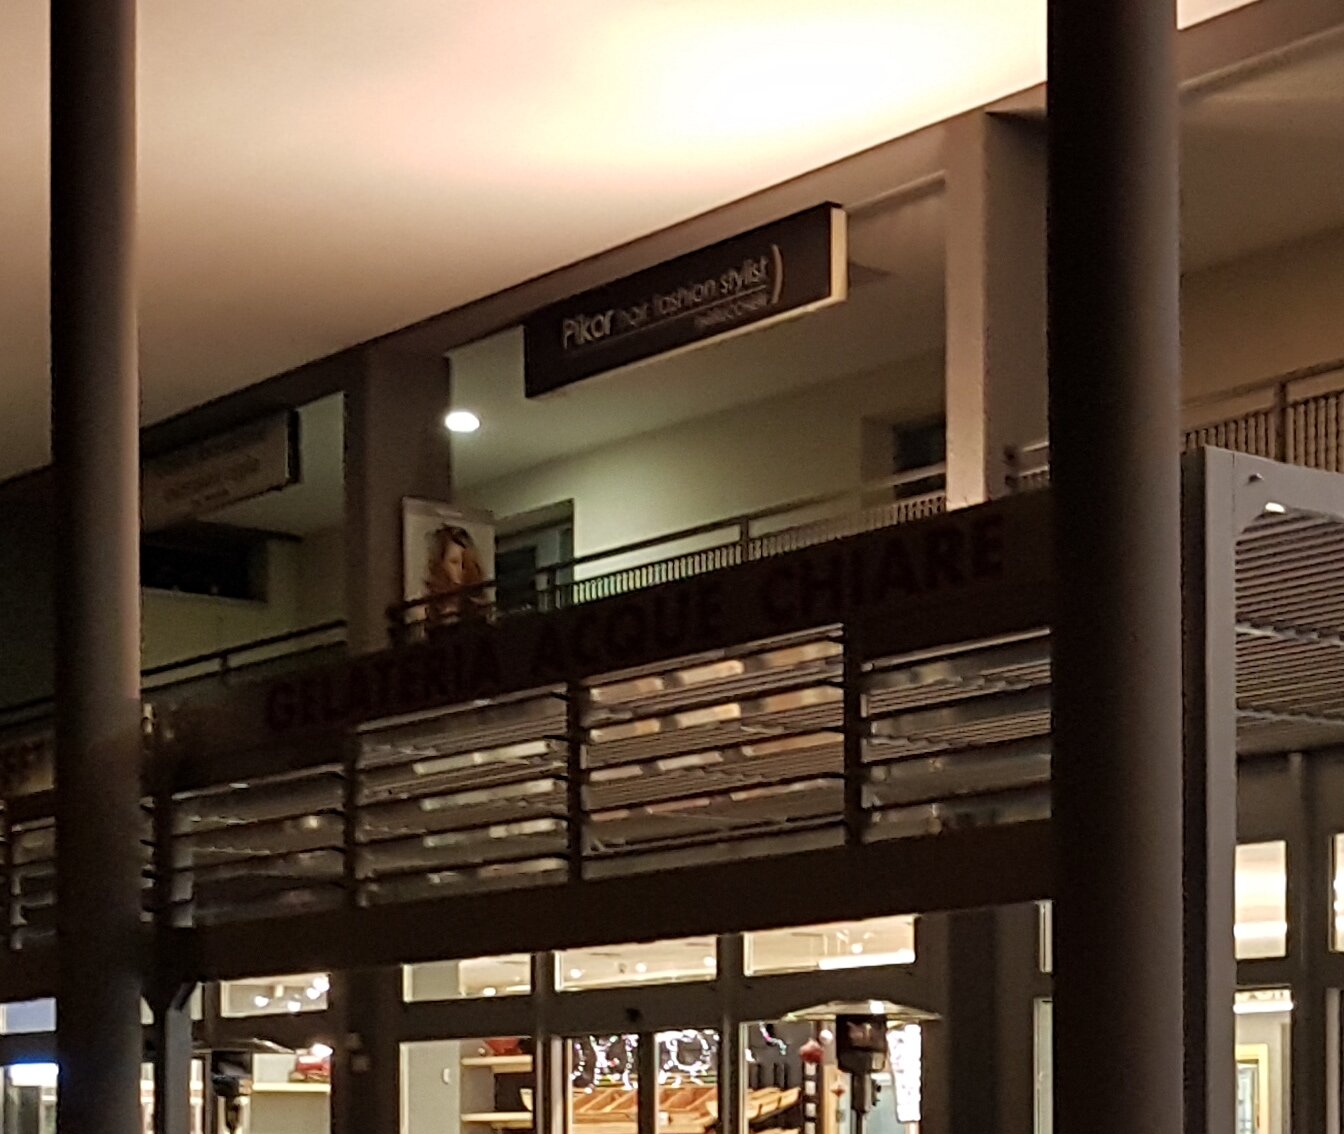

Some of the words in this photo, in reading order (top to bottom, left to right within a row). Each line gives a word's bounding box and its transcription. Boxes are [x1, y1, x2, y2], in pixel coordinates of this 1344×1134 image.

[265, 637, 501, 731] GELATERIA
[531, 583, 723, 672] ACQUE
[762, 513, 1005, 625] CHIARE
